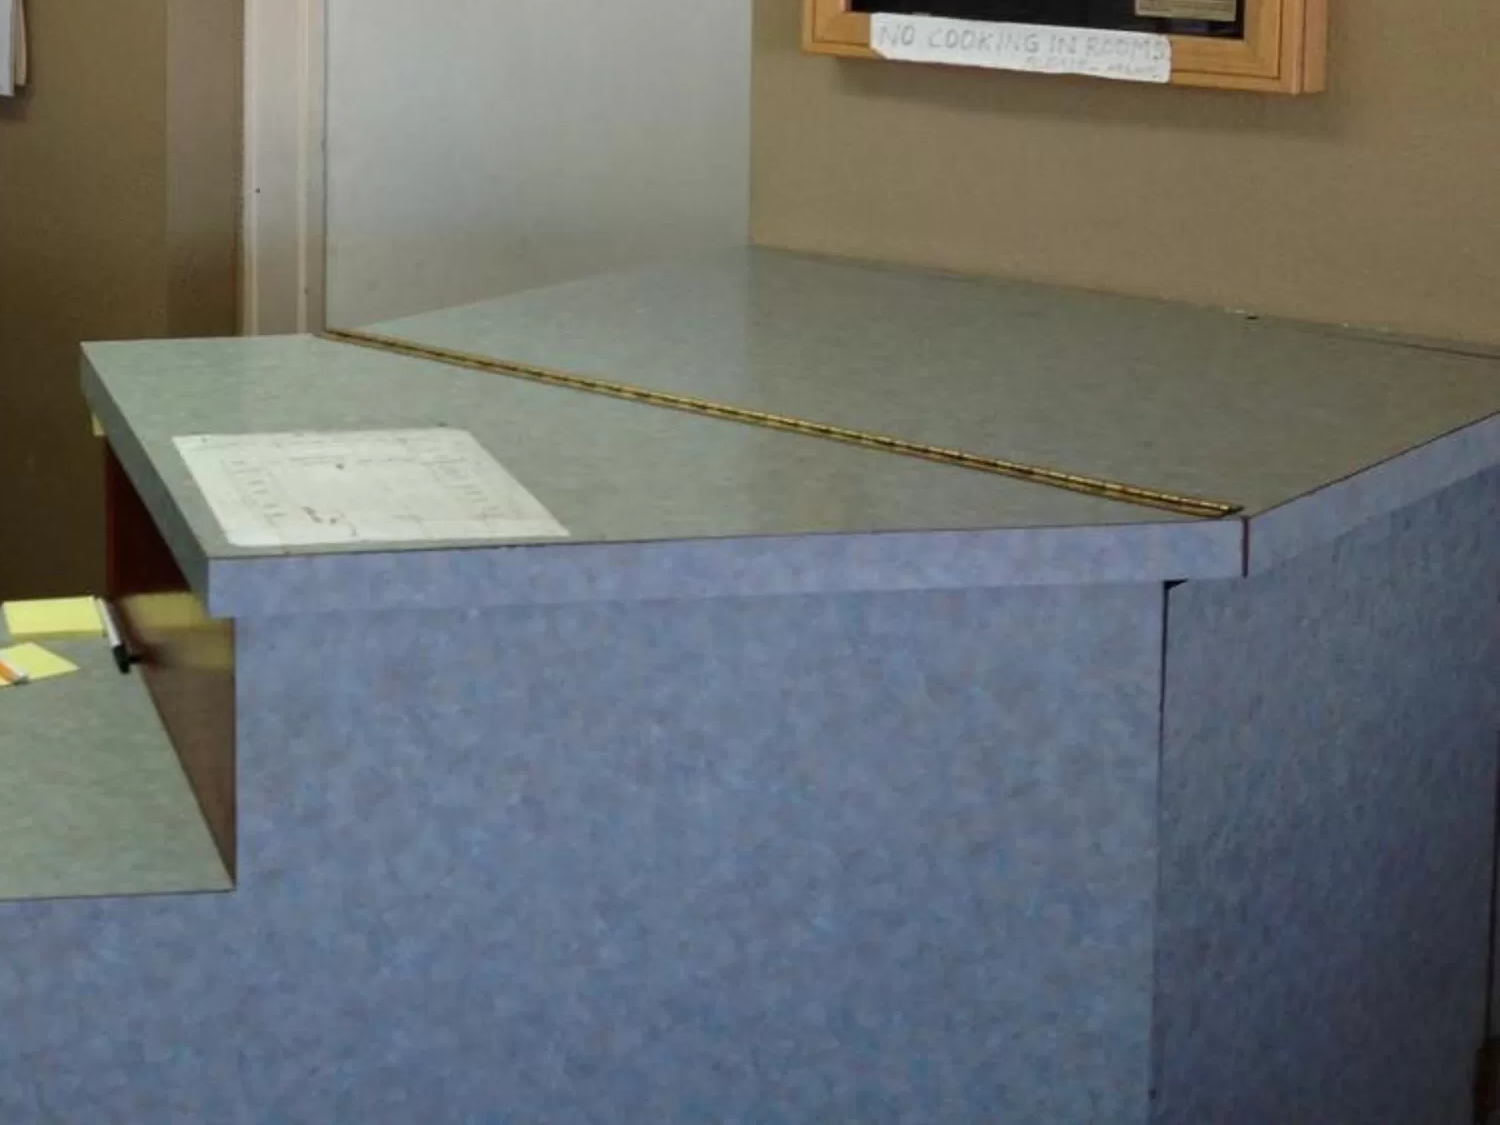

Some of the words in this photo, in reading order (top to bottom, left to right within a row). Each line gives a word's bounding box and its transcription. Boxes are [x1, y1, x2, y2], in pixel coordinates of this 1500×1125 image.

[880, 24, 916, 48] NO
[927, 27, 1040, 55] COOKING
[1050, 34, 1077, 55] IN
